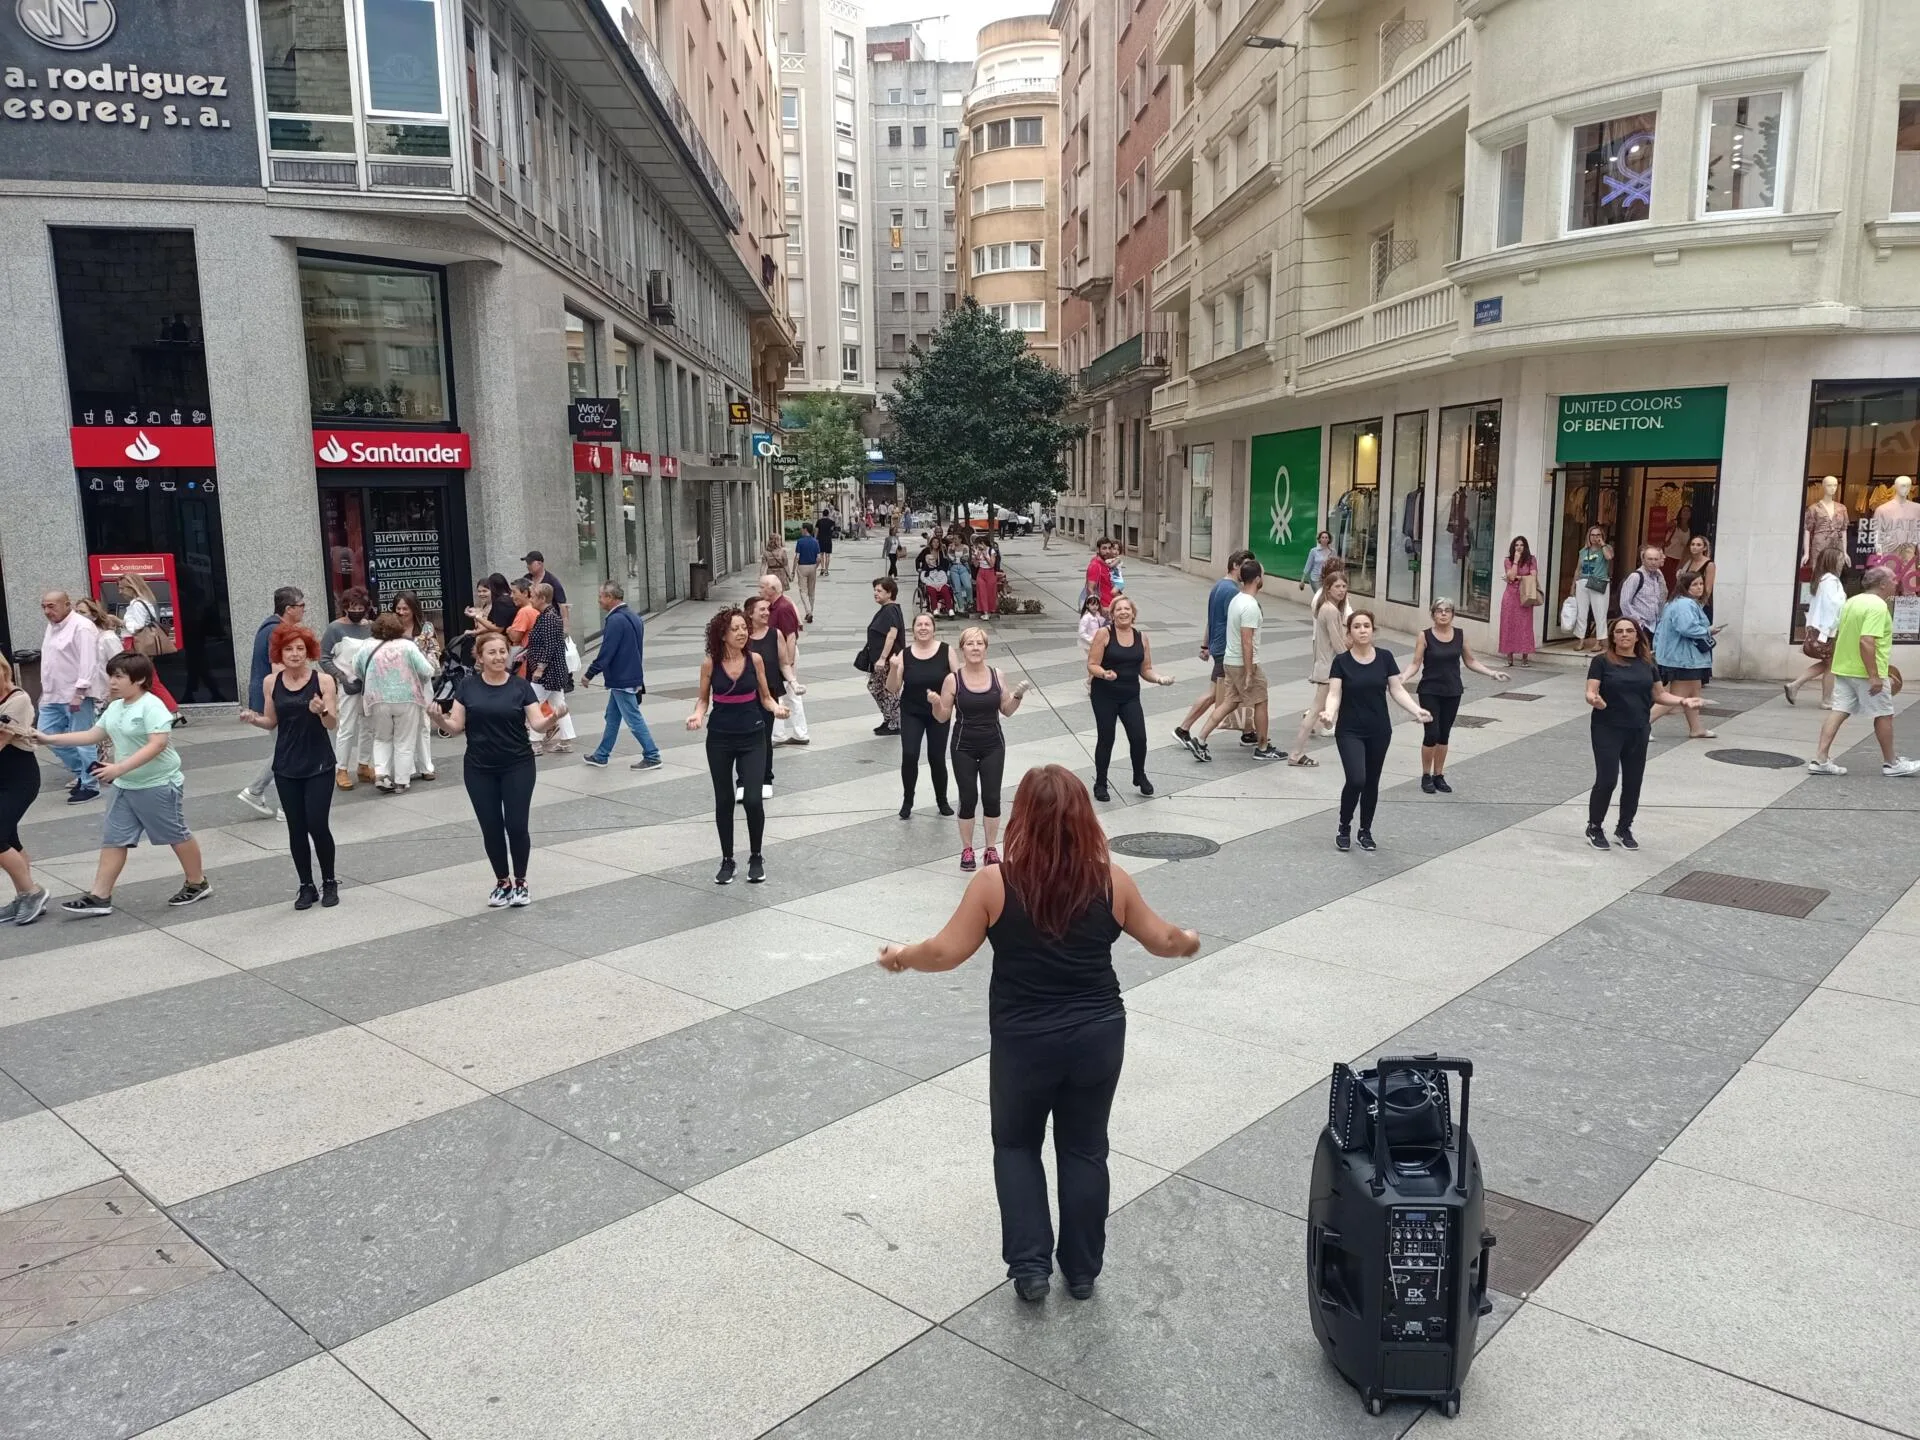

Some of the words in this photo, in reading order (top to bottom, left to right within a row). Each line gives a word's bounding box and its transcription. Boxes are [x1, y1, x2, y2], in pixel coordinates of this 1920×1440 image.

[4, 66, 37, 88] a.
[47, 63, 228, 99] rodriguez
[0, 98, 149, 130] esores,
[163, 104, 190, 126] s.
[200, 106, 231, 128] a.
[577, 403, 604, 414] Work
[1564, 400, 1617, 415] UNITED
[1620, 396, 1682, 412] COLORS
[578, 413, 600, 424] Café
[1562, 419, 1582, 433] OF
[1585, 416, 1664, 432] BENETTON.
[351, 442, 462, 463] Santander
